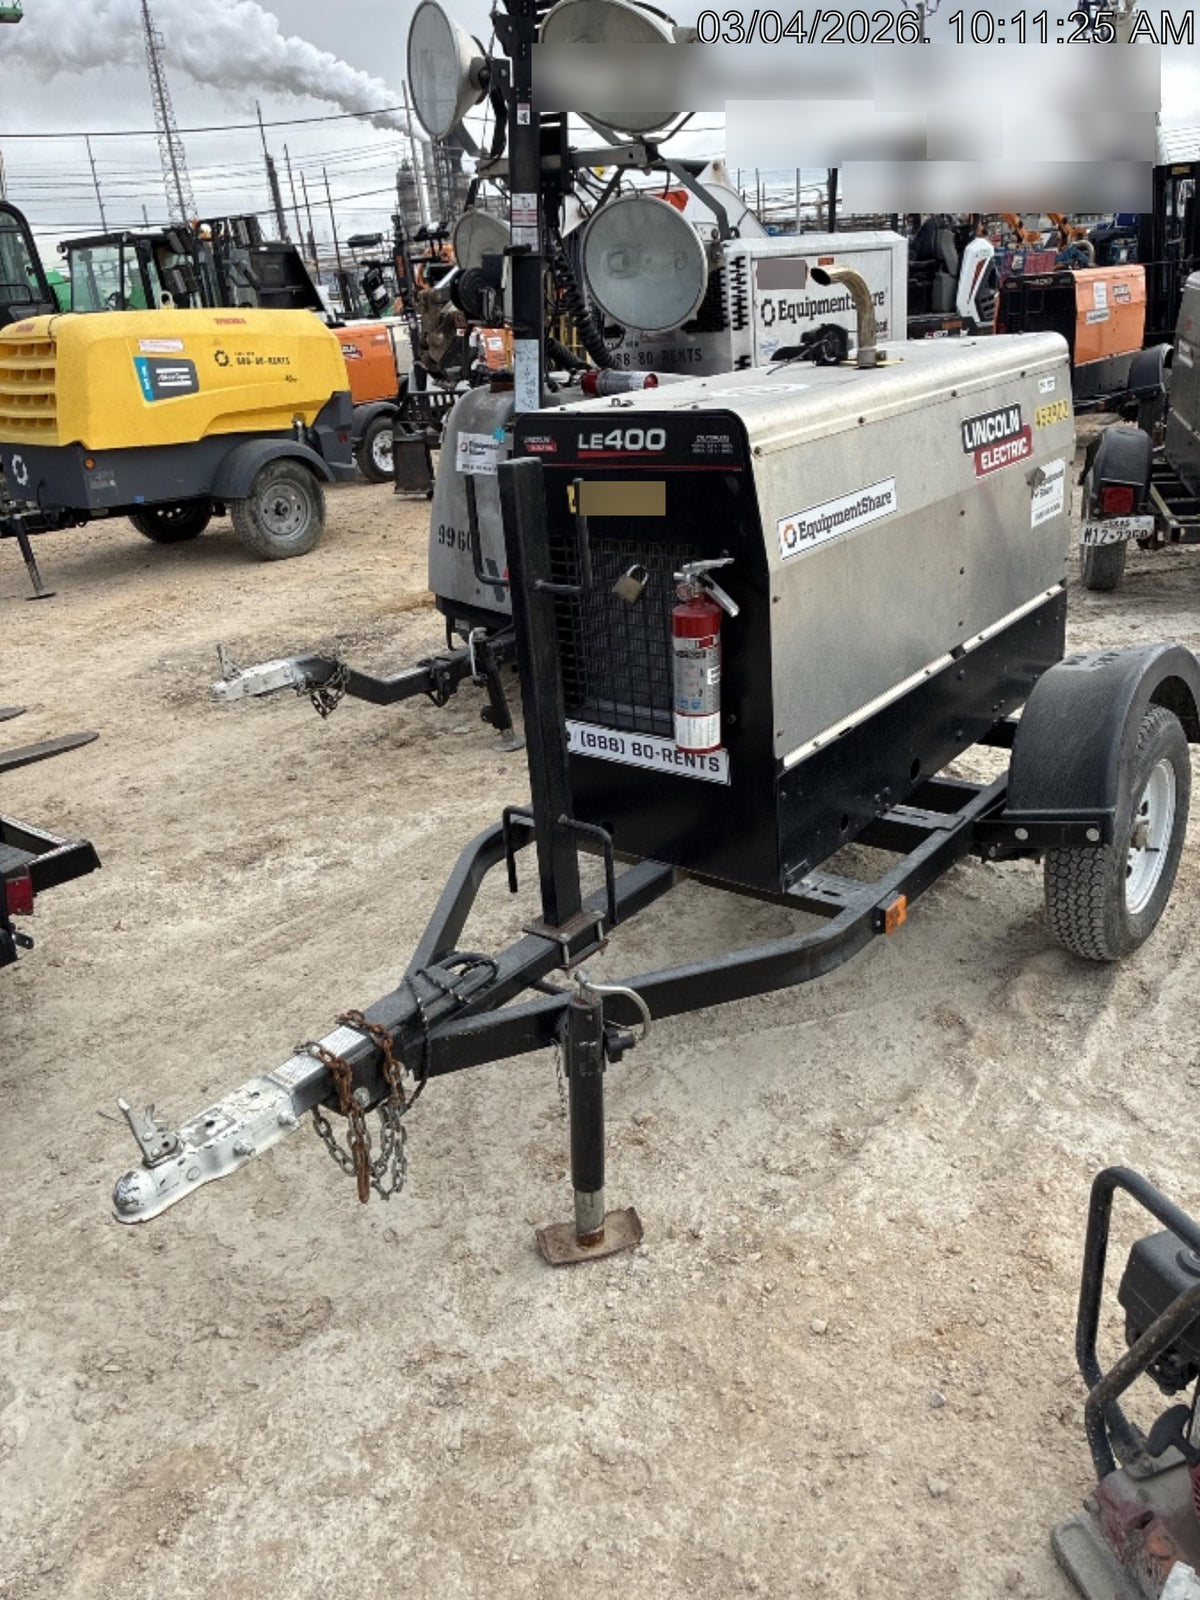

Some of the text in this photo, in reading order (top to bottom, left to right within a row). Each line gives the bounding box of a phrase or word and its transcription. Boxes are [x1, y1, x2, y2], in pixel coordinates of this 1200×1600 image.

[778, 291, 885, 323] Equipmentre
[661, 348, 703, 364] RENTS
[577, 428, 667, 450] LE400
[963, 407, 1021, 449] LINCOLN
[980, 436, 1029, 470] ELECTRIC
[798, 491, 892, 540] EquipmentShare
[580, 730, 625, 754] (888)
